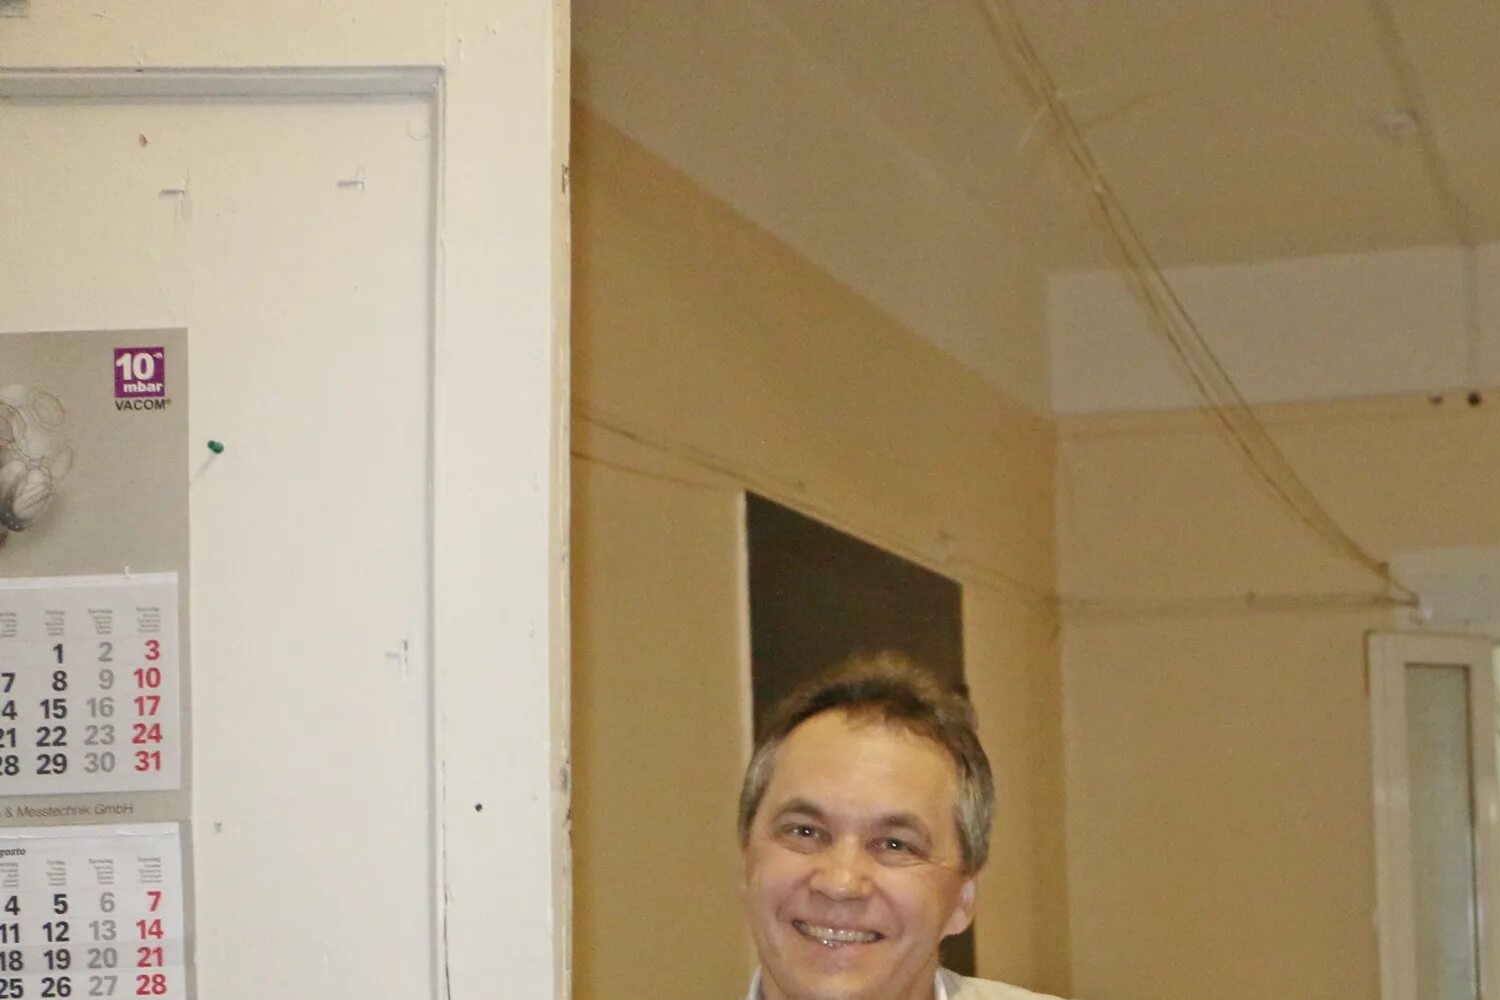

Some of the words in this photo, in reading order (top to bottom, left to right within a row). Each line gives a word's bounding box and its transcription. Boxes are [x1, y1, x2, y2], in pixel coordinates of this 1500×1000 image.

[123, 380, 163, 393] mbar
[54, 644, 63, 663] 1
[98, 642, 112, 662] 2
[145, 640, 160, 660] 3
[1, 673, 15, 693] 7
[52, 671, 67, 691] 8
[99, 669, 114, 690] 9
[134, 668, 161, 688] 10
[2, 700, 17, 720] 4
[40, 699, 67, 719] 15
[87, 697, 114, 718] 16
[134, 695, 160, 716] 17
[36, 726, 67, 747] 22
[84, 724, 115, 745] 23
[132, 723, 163, 744] 24
[0, 755, 19, 776] 8
[37, 753, 67, 774] 29
[84, 752, 115, 773] 30
[135, 751, 160, 771] 31
[0, 848, 26, 858] gosto
[5, 896, 20, 915] 4
[54, 894, 68, 914] 5
[100, 892, 115, 912] 6
[147, 891, 161, 911] 7
[43, 921, 69, 942] 12
[89, 920, 116, 940] 13
[136, 919, 164, 939] 14
[44, 949, 71, 970] 19
[88, 948, 117, 969] 20
[137, 947, 162, 967] 21
[41, 977, 71, 998] 26
[89, 975, 117, 996] 27
[136, 974, 167, 995] 28
